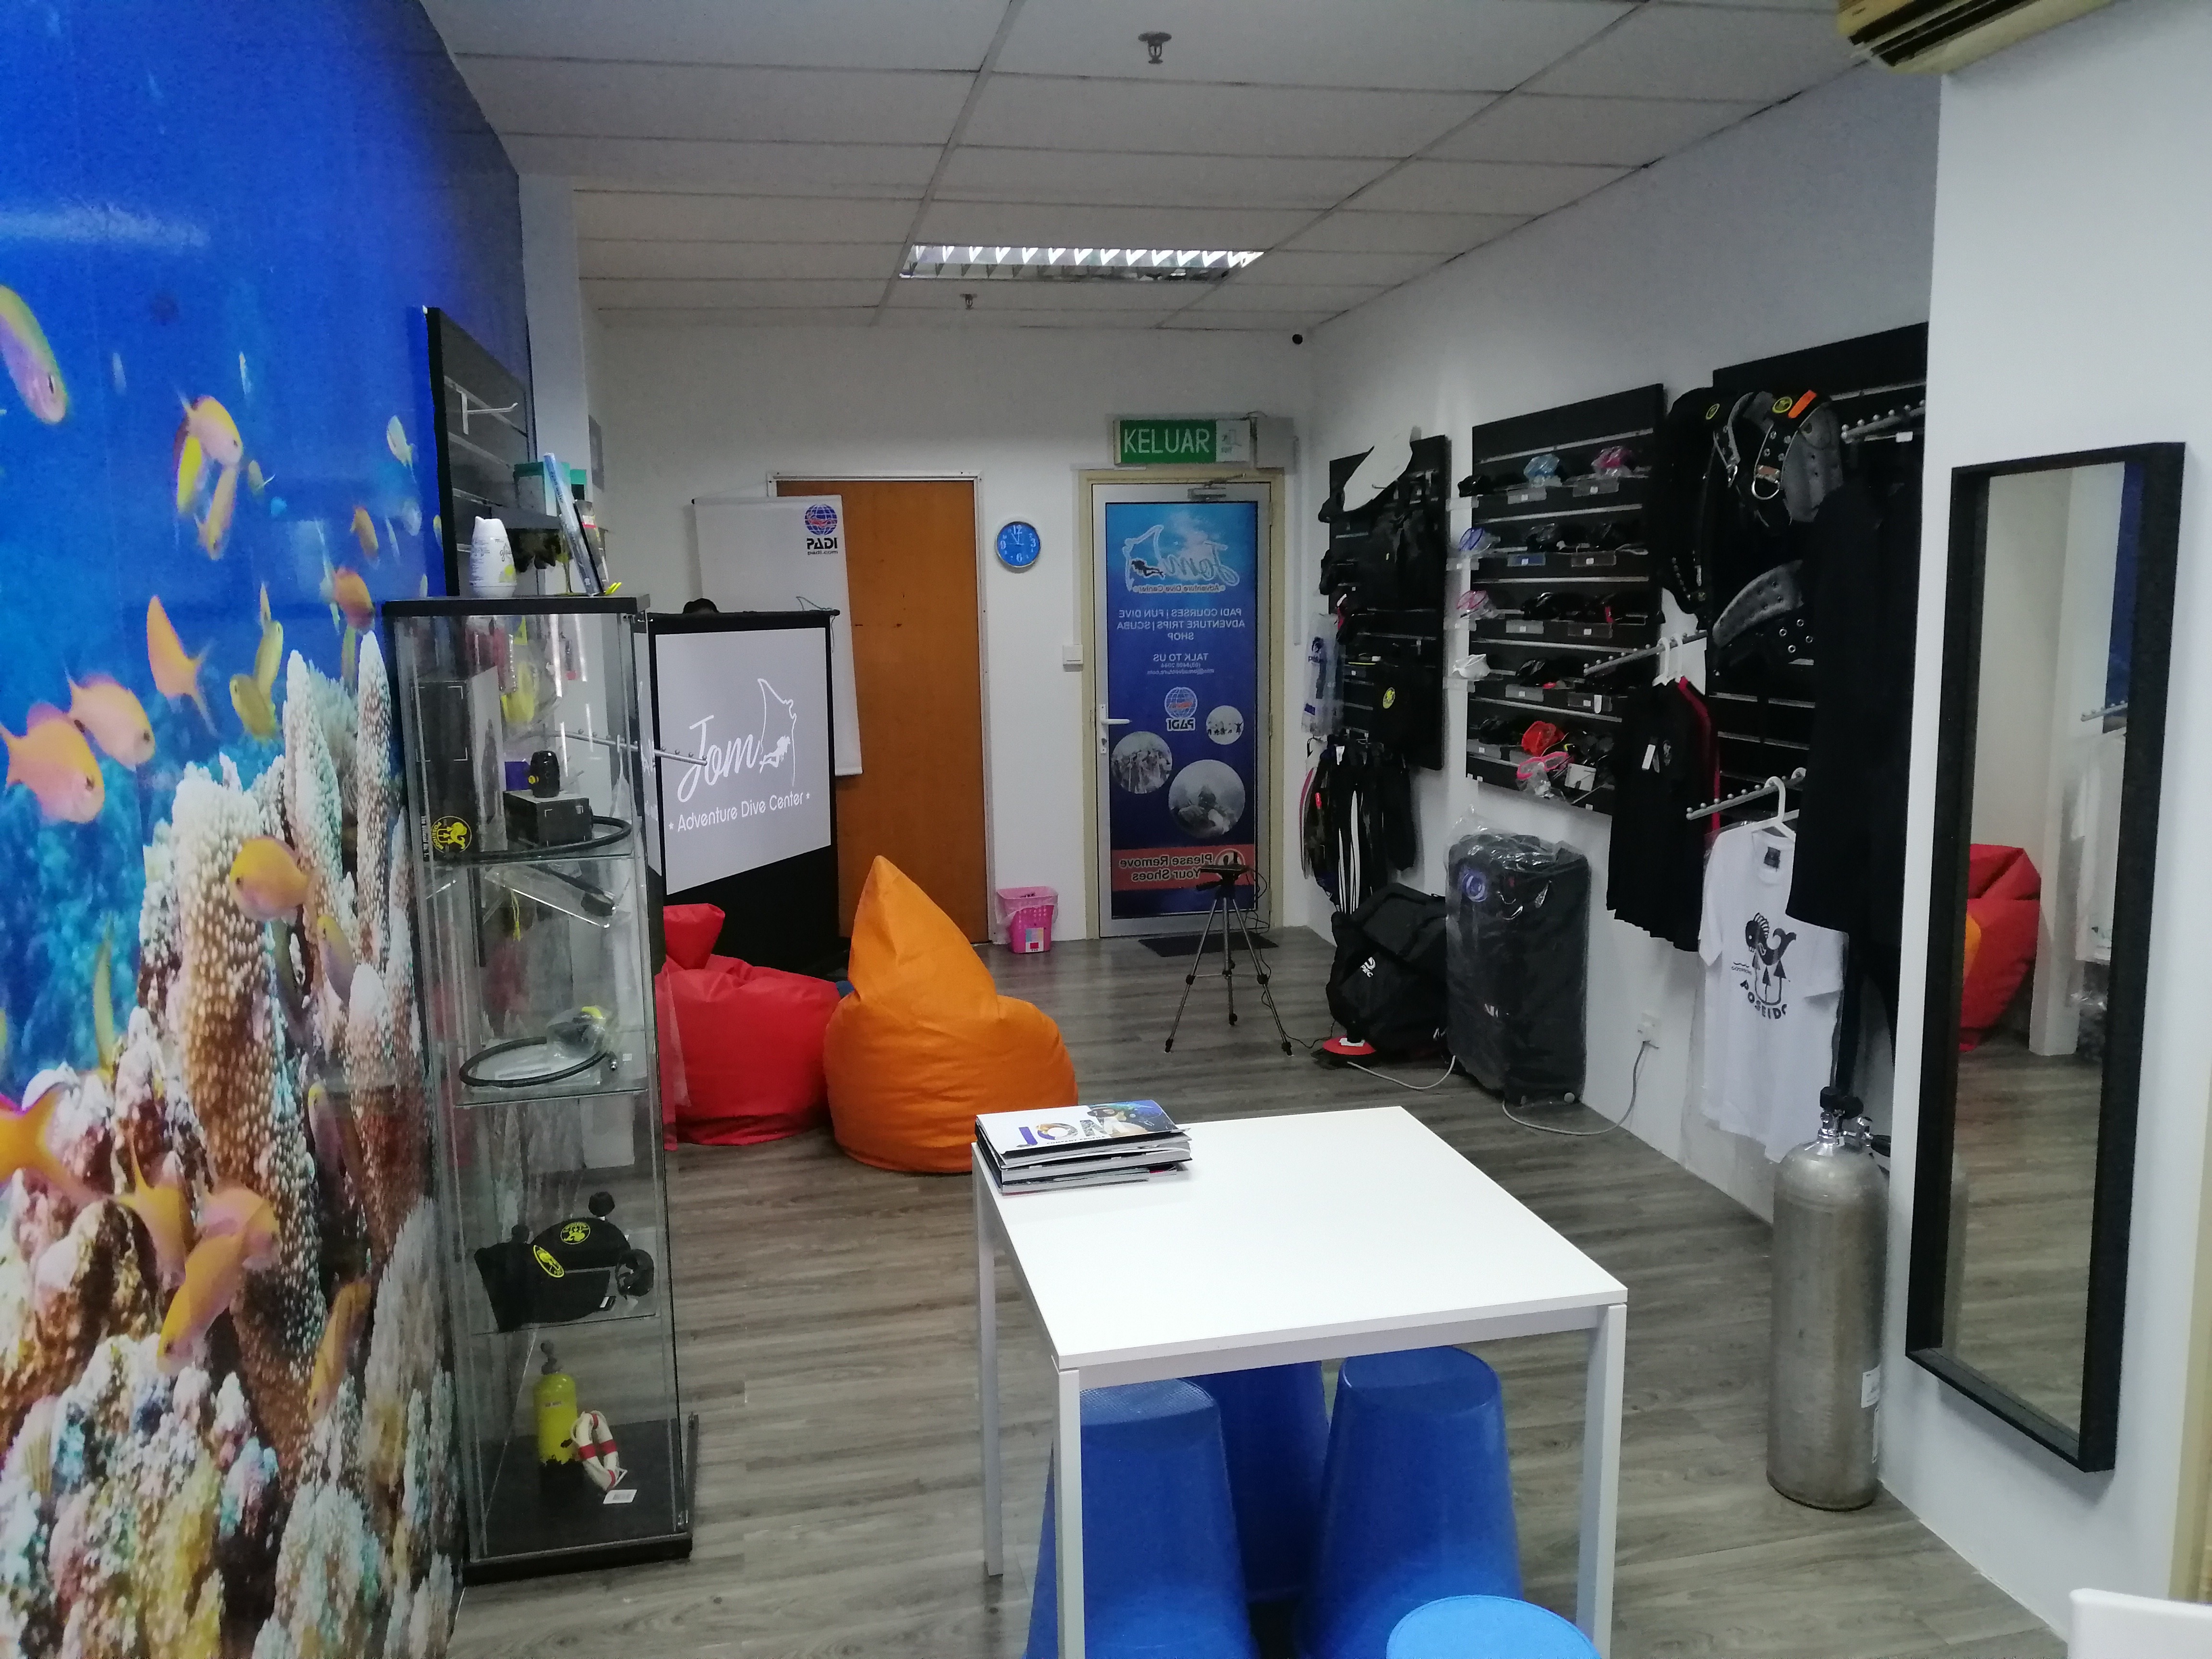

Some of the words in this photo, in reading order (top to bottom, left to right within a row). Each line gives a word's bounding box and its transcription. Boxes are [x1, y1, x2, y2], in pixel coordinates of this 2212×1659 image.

[1124, 428, 1210, 453] KELUAR
[807, 538, 838, 550] PADI
[677, 715, 761, 802] Jom
[678, 807, 737, 832] Adventure
[741, 799, 766, 817] Dive
[769, 791, 804, 810] Center
